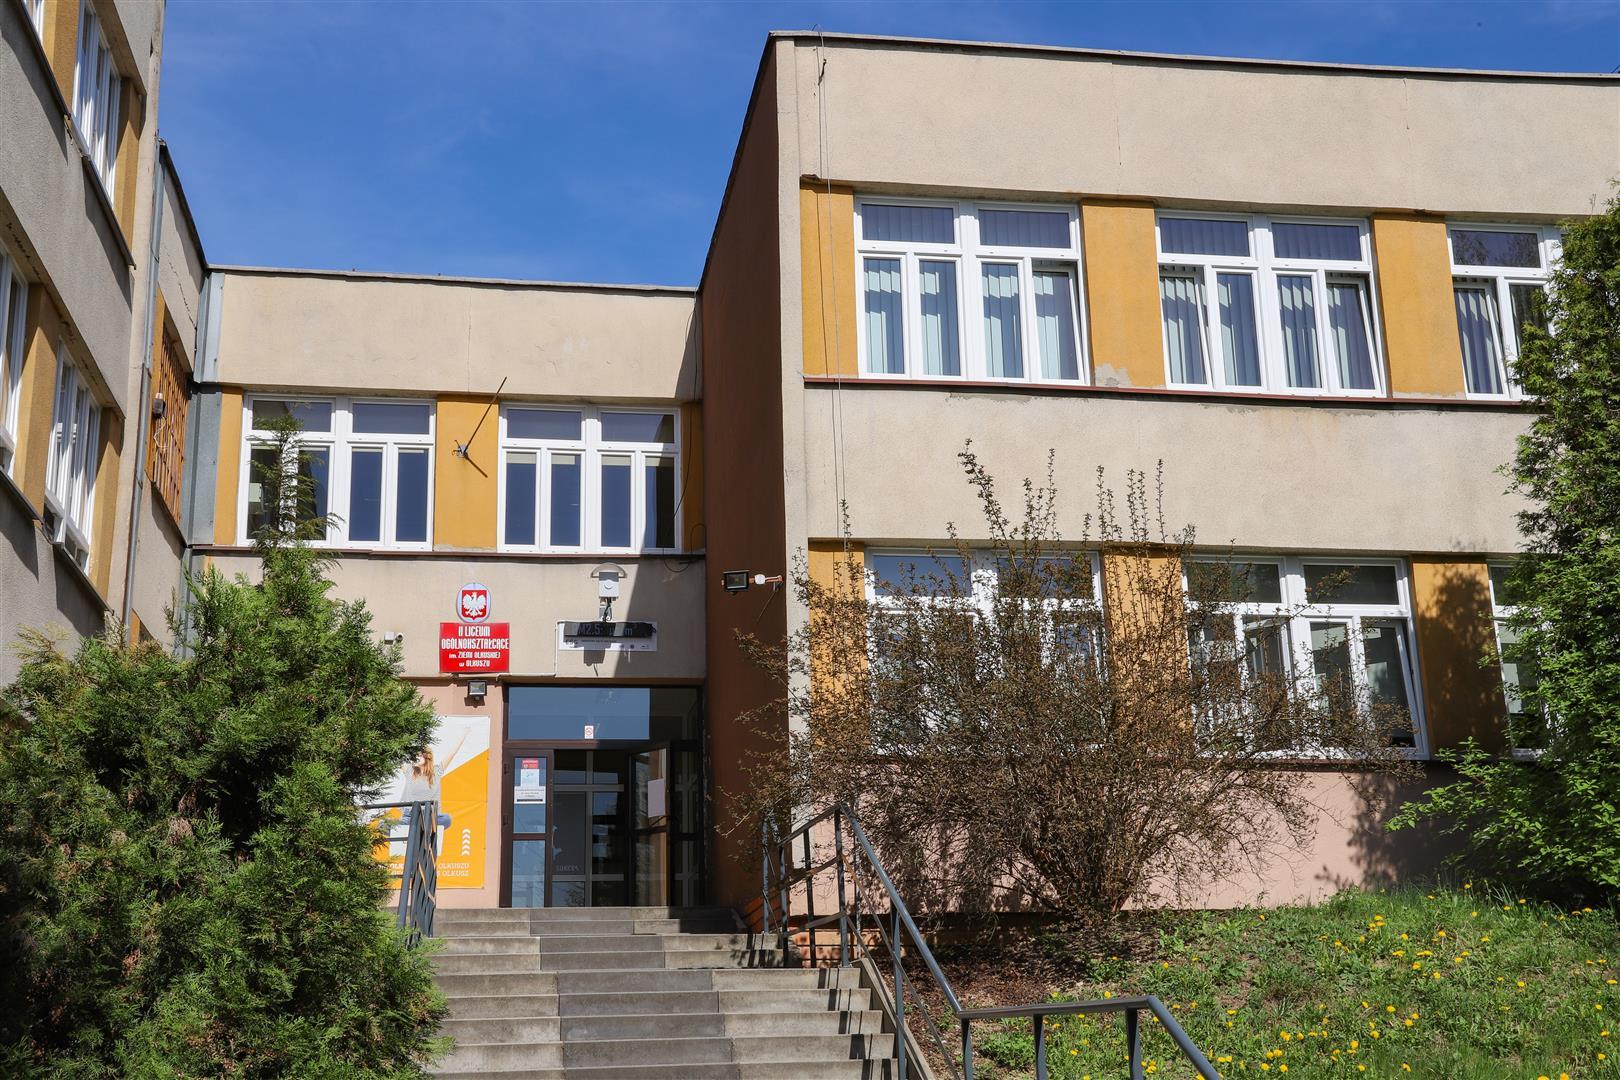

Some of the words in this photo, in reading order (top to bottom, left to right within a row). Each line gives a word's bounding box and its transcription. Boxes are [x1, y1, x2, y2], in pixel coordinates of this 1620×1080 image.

[458, 626, 463, 637] II
[465, 626, 490, 637] LICEUM
[441, 637, 509, 650] OGÓLNOKSZTAŁCĄCE
[458, 651, 473, 659] ZIEMI
[474, 651, 501, 659] OLKUSKIEJ
[466, 659, 490, 667] OLKUSZU
